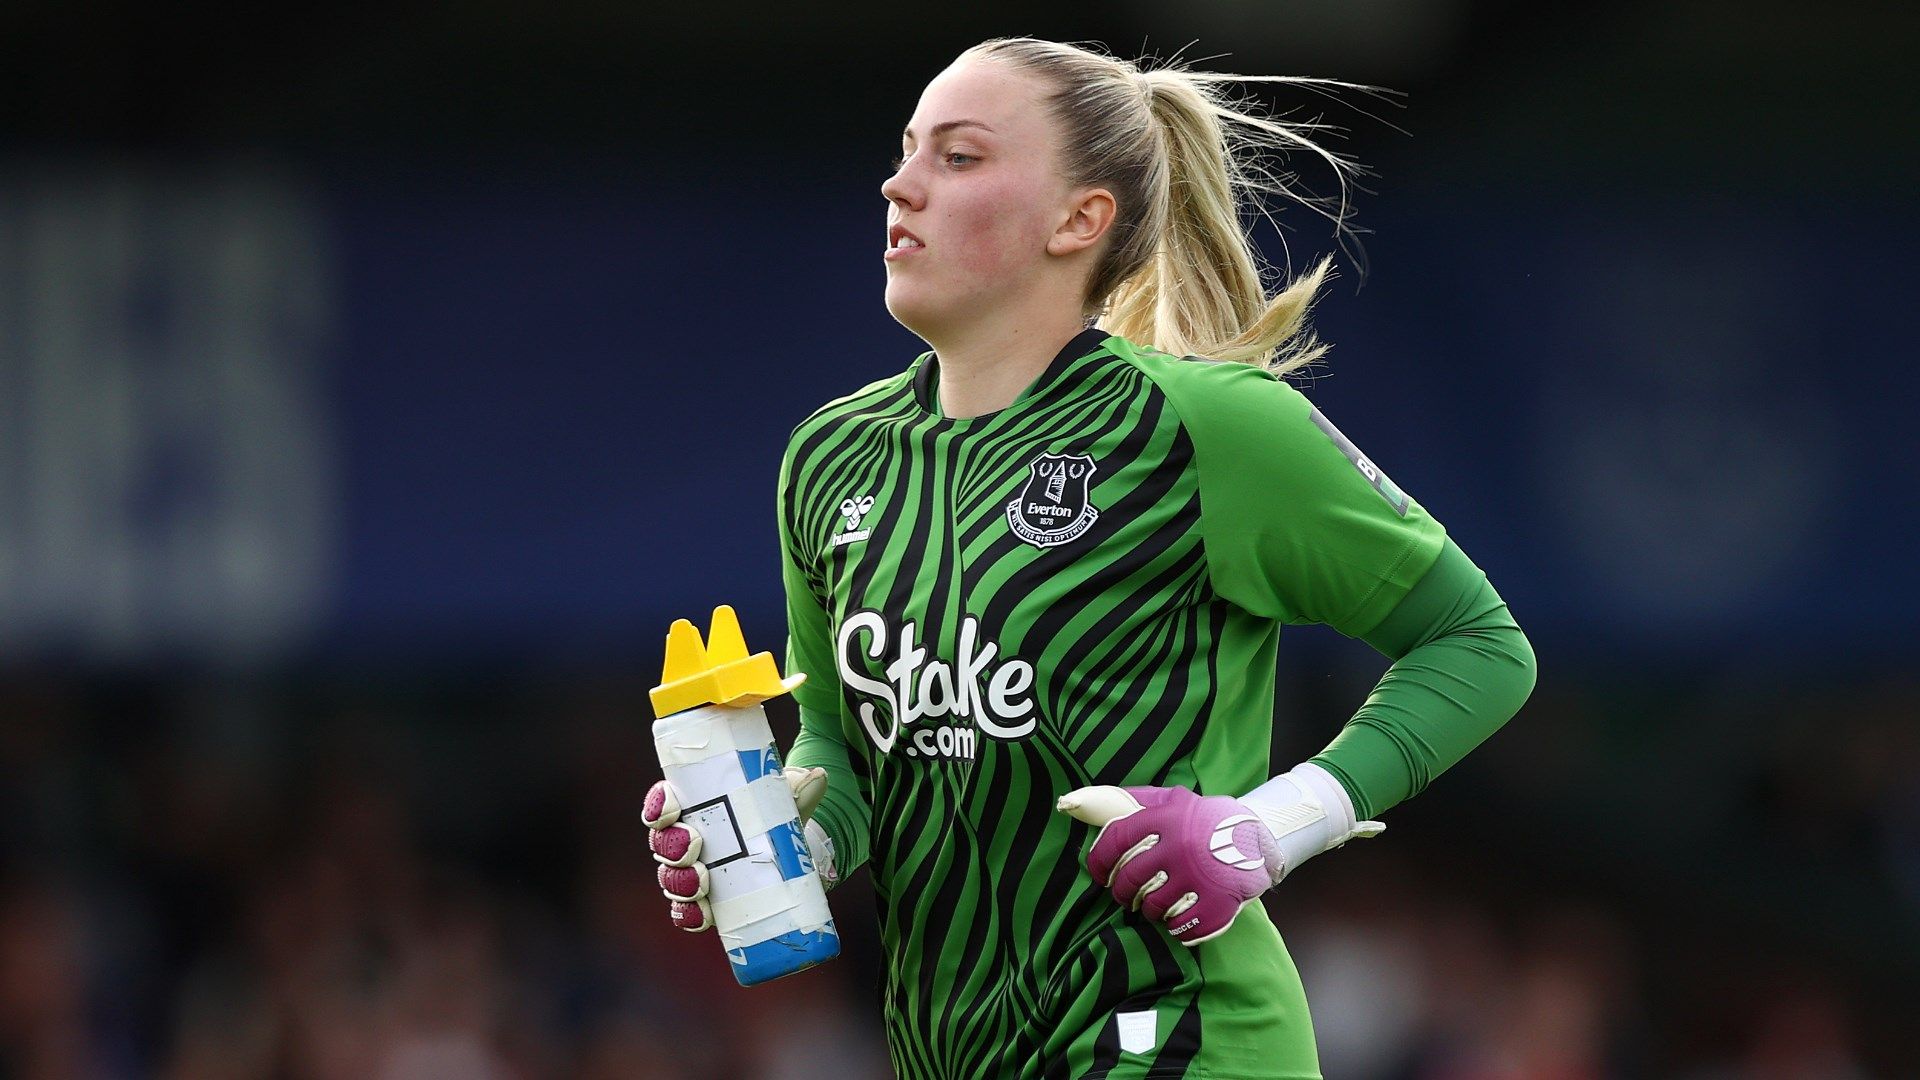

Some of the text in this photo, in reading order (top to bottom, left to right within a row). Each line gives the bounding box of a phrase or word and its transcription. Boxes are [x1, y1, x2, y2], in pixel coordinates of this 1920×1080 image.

[1027, 502, 1072, 518] Everton
[1016, 525, 1036, 540] SATIS
[1054, 519, 1088, 542] OPTIMUM
[1039, 517, 1054, 526] 1878
[831, 526, 872, 547] hummel
[837, 611, 1037, 754] Stake
[906, 725, 976, 760] .com
